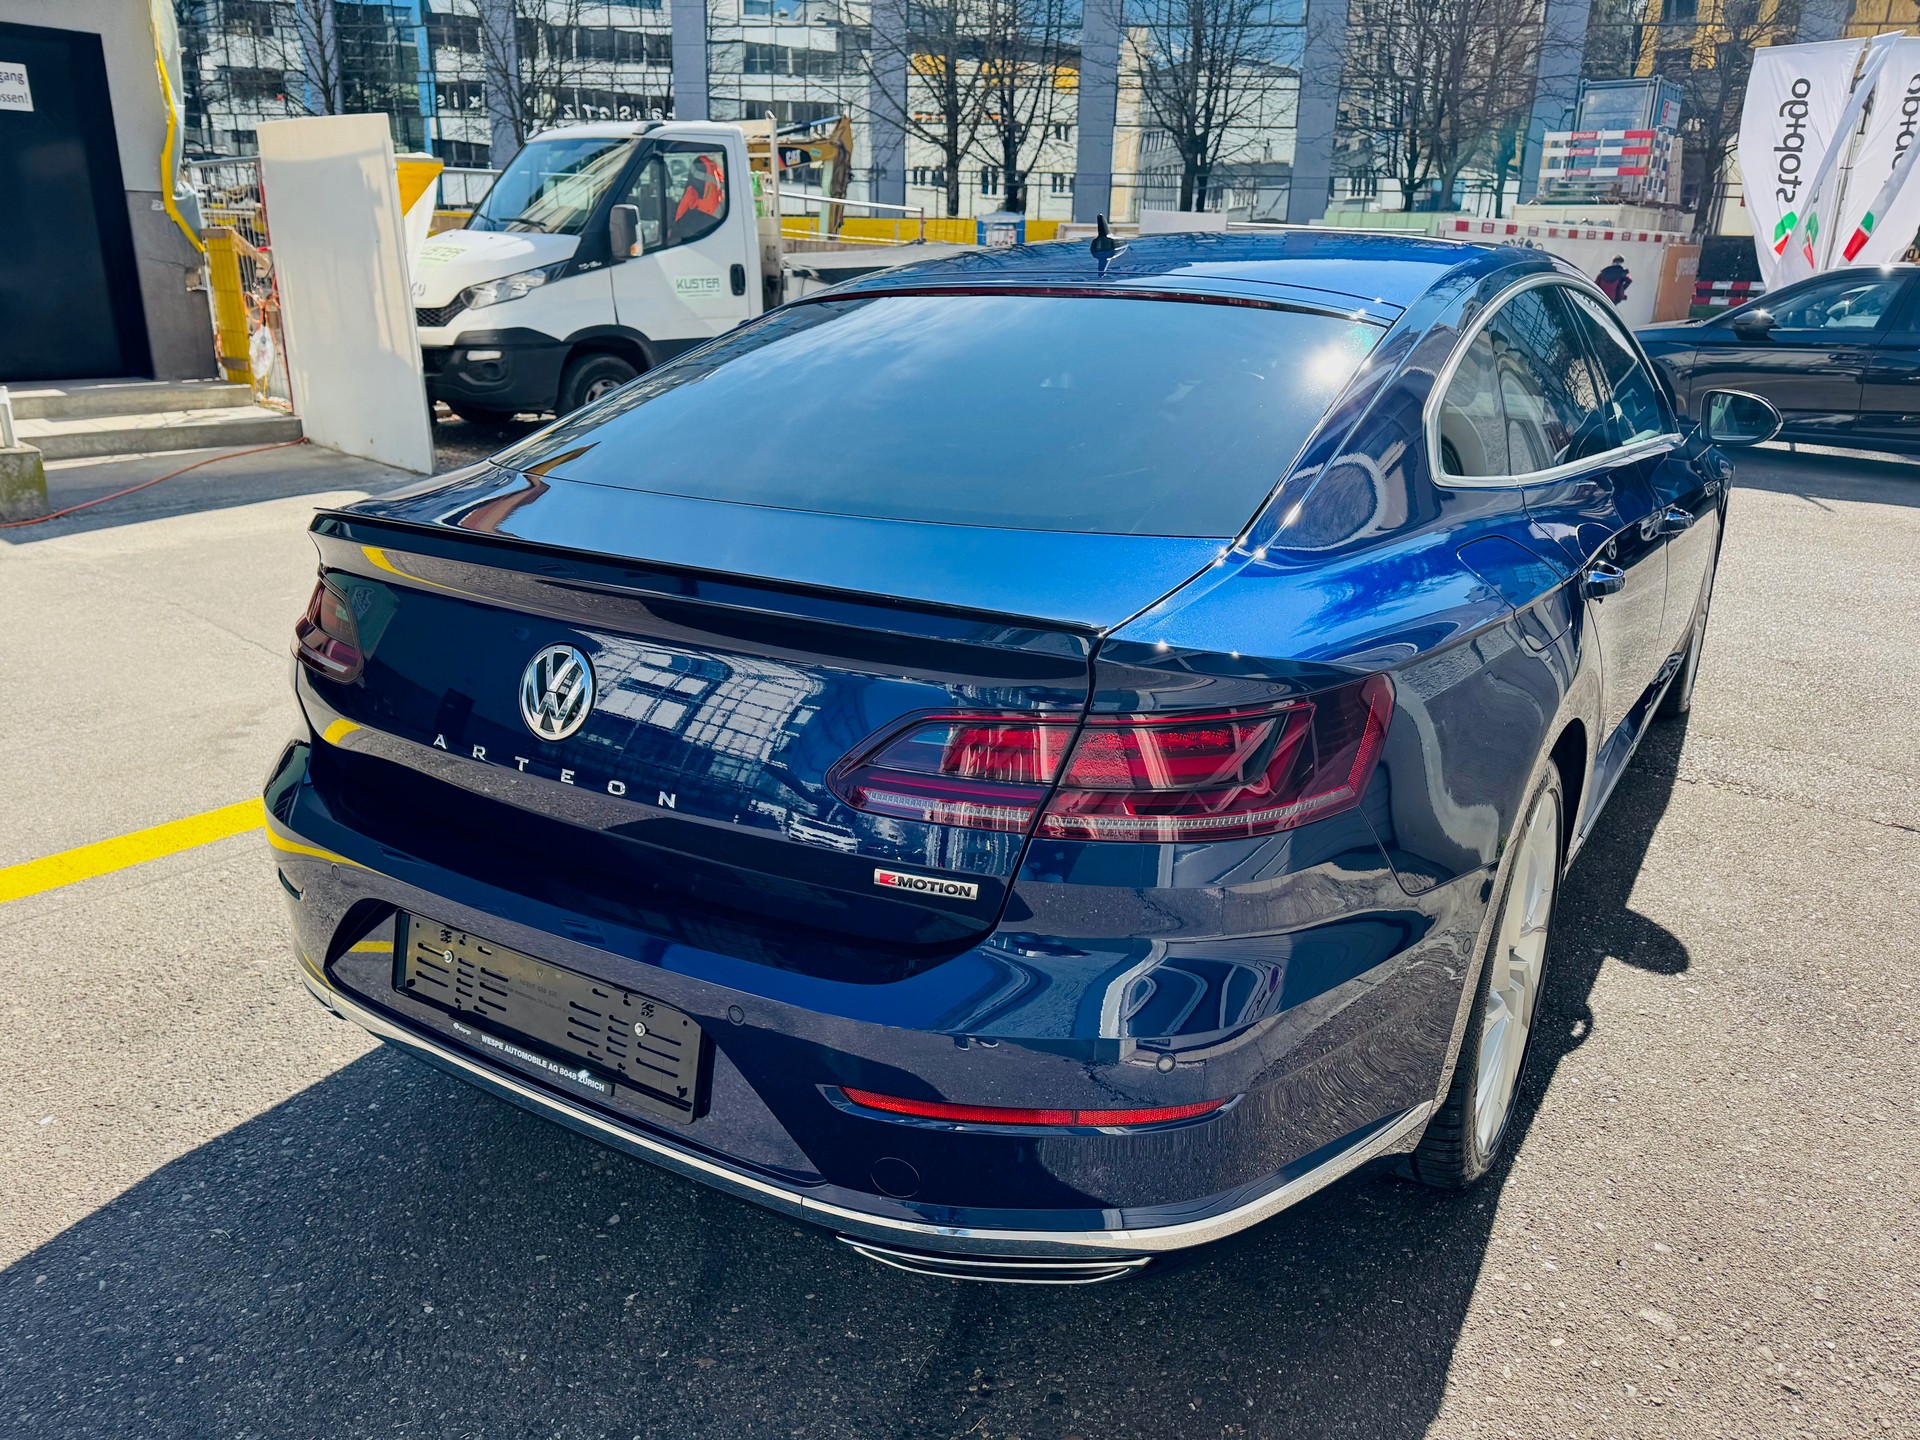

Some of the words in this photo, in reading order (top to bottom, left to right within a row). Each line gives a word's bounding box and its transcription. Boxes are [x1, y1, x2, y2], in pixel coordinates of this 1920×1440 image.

[1572, 131, 1596, 140] greuter
[785, 149, 801, 166] CAT
[1570, 148, 1594, 156] greuter
[676, 278, 720, 289] KUSTER
[433, 733, 677, 809] ARTEON
[886, 876, 972, 898] 4MOTION
[481, 1034, 504, 1050] WESPE
[504, 1044, 548, 1069] AUTOMOBILE
[559, 1067, 577, 1081] 8048
